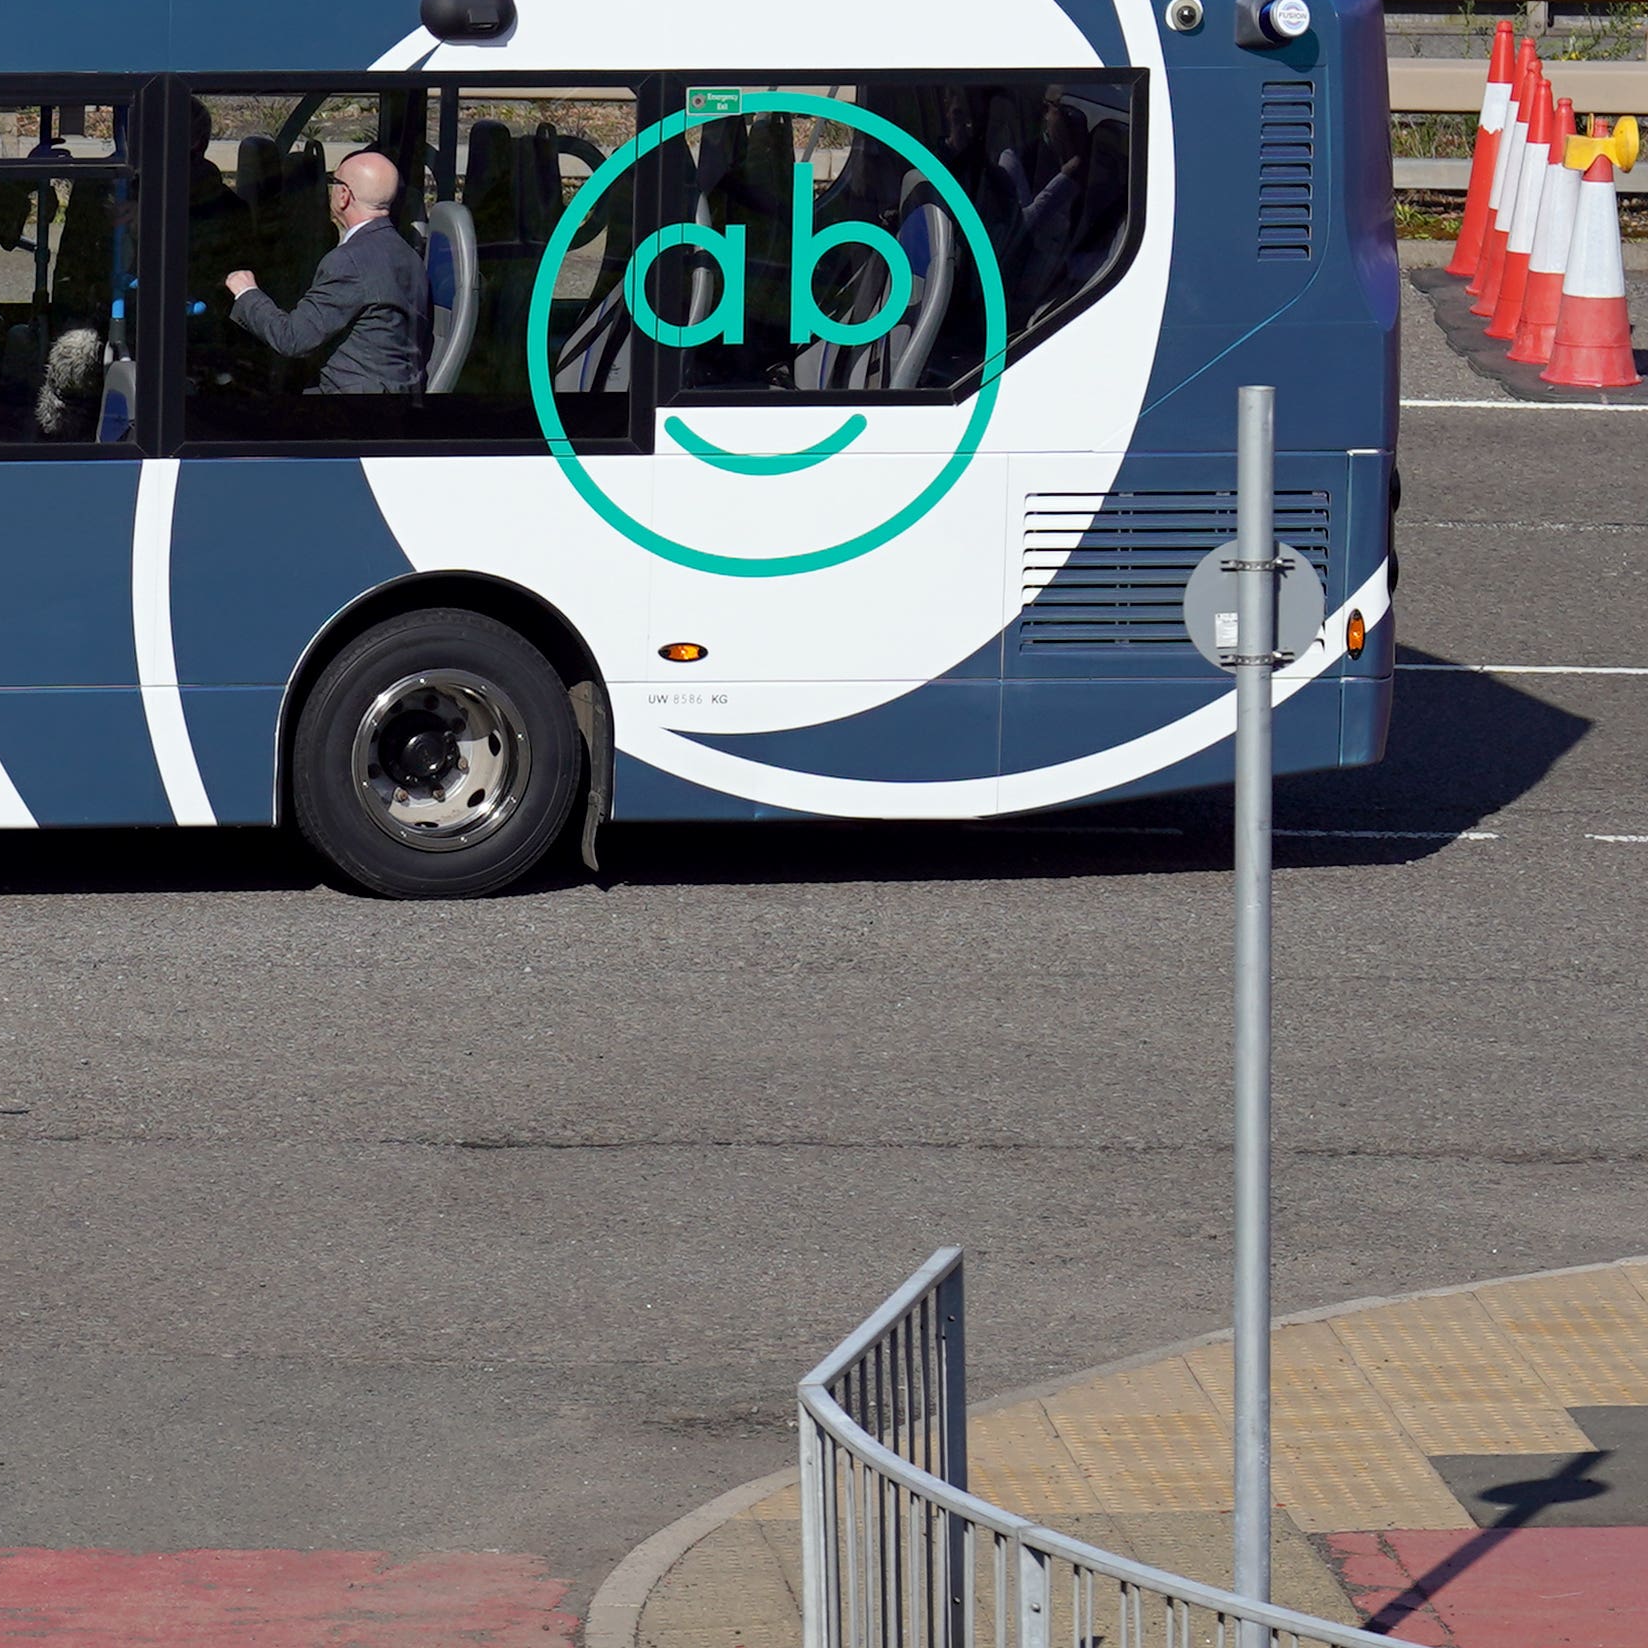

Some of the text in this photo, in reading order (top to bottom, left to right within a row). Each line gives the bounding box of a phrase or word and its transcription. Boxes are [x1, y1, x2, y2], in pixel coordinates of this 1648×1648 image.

[1278, 12, 1307, 20] FUSION
[624, 162, 913, 348] ab
[648, 694, 728, 704] UW 8586 KG
